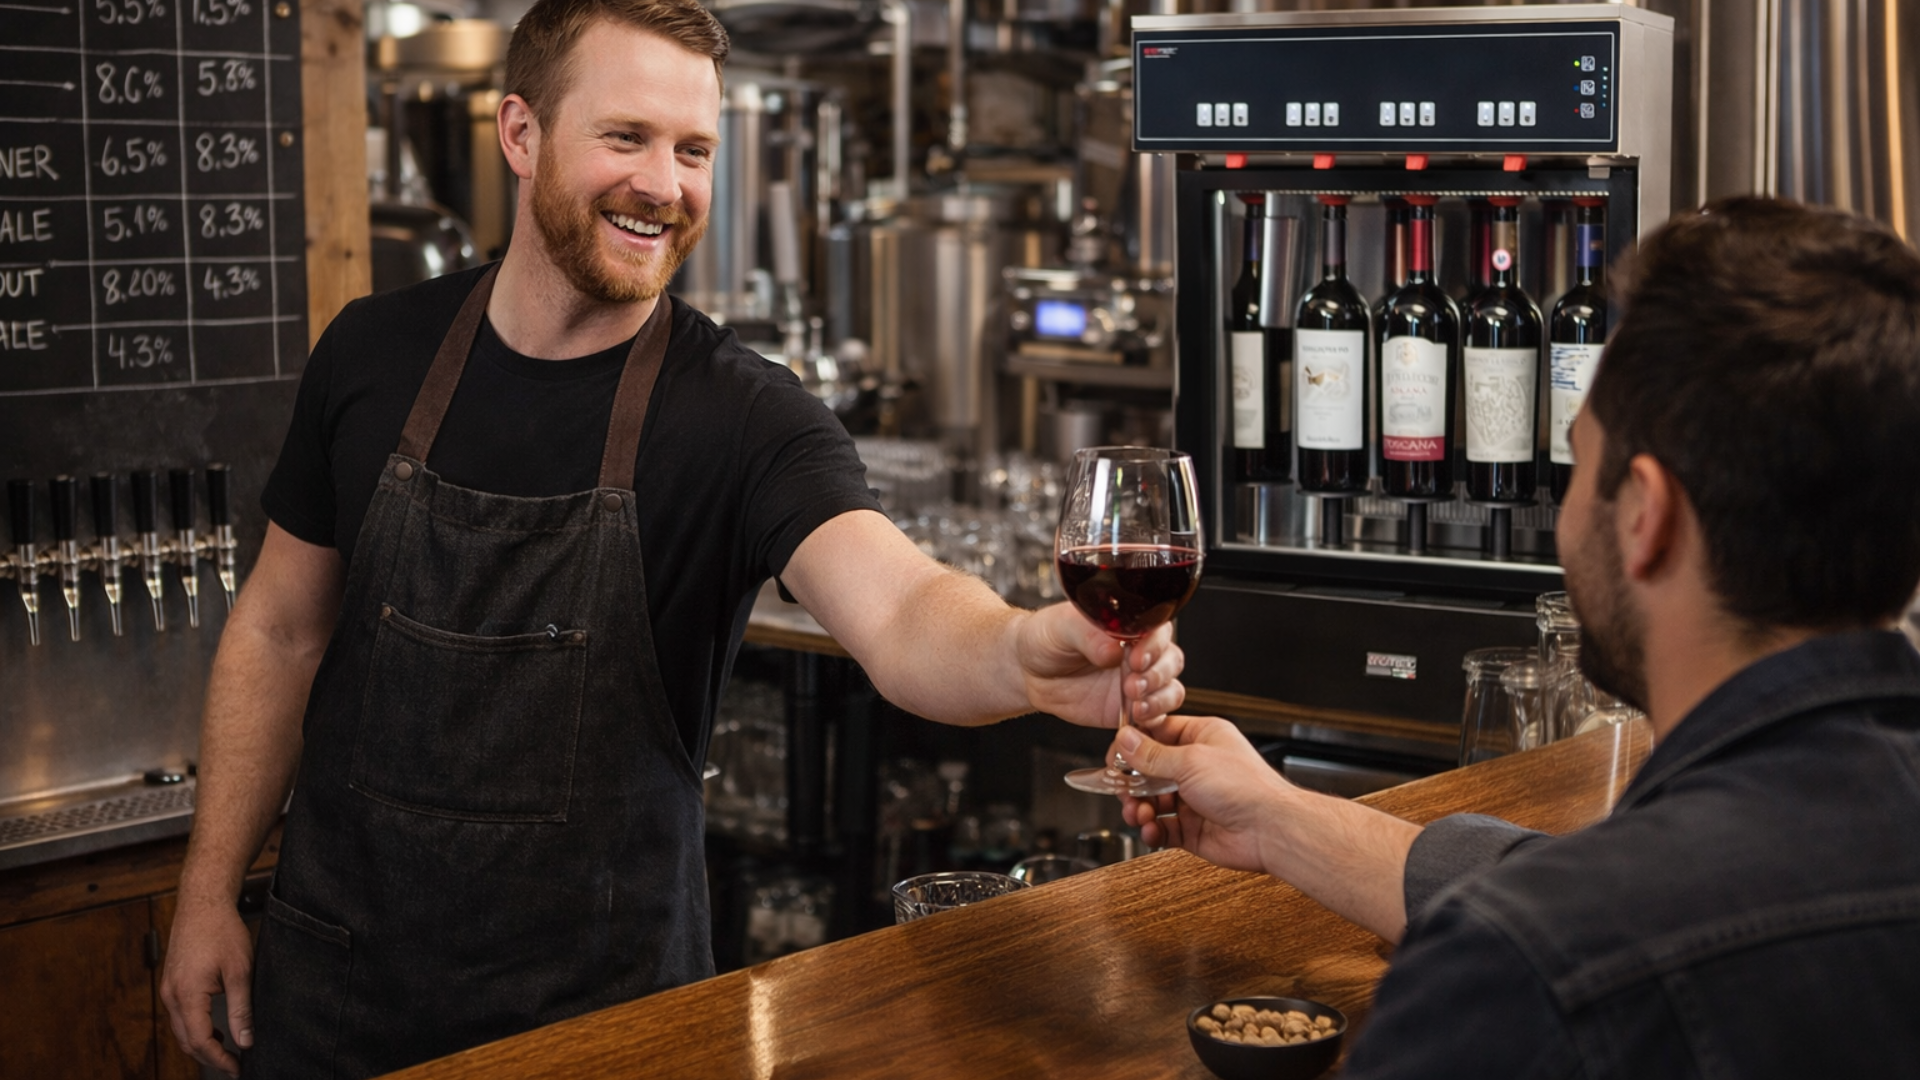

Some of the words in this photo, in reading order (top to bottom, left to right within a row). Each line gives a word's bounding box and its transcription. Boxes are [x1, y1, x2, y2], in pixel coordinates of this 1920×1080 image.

[100, 137, 167, 176] 6.5%
[195, 132, 259, 172] 8.3%
[0, 208, 53, 244] ALE
[200, 203, 263, 238] 8.3%
[203, 266, 260, 300] 4.3%
[108, 334, 173, 369] 4.3%
